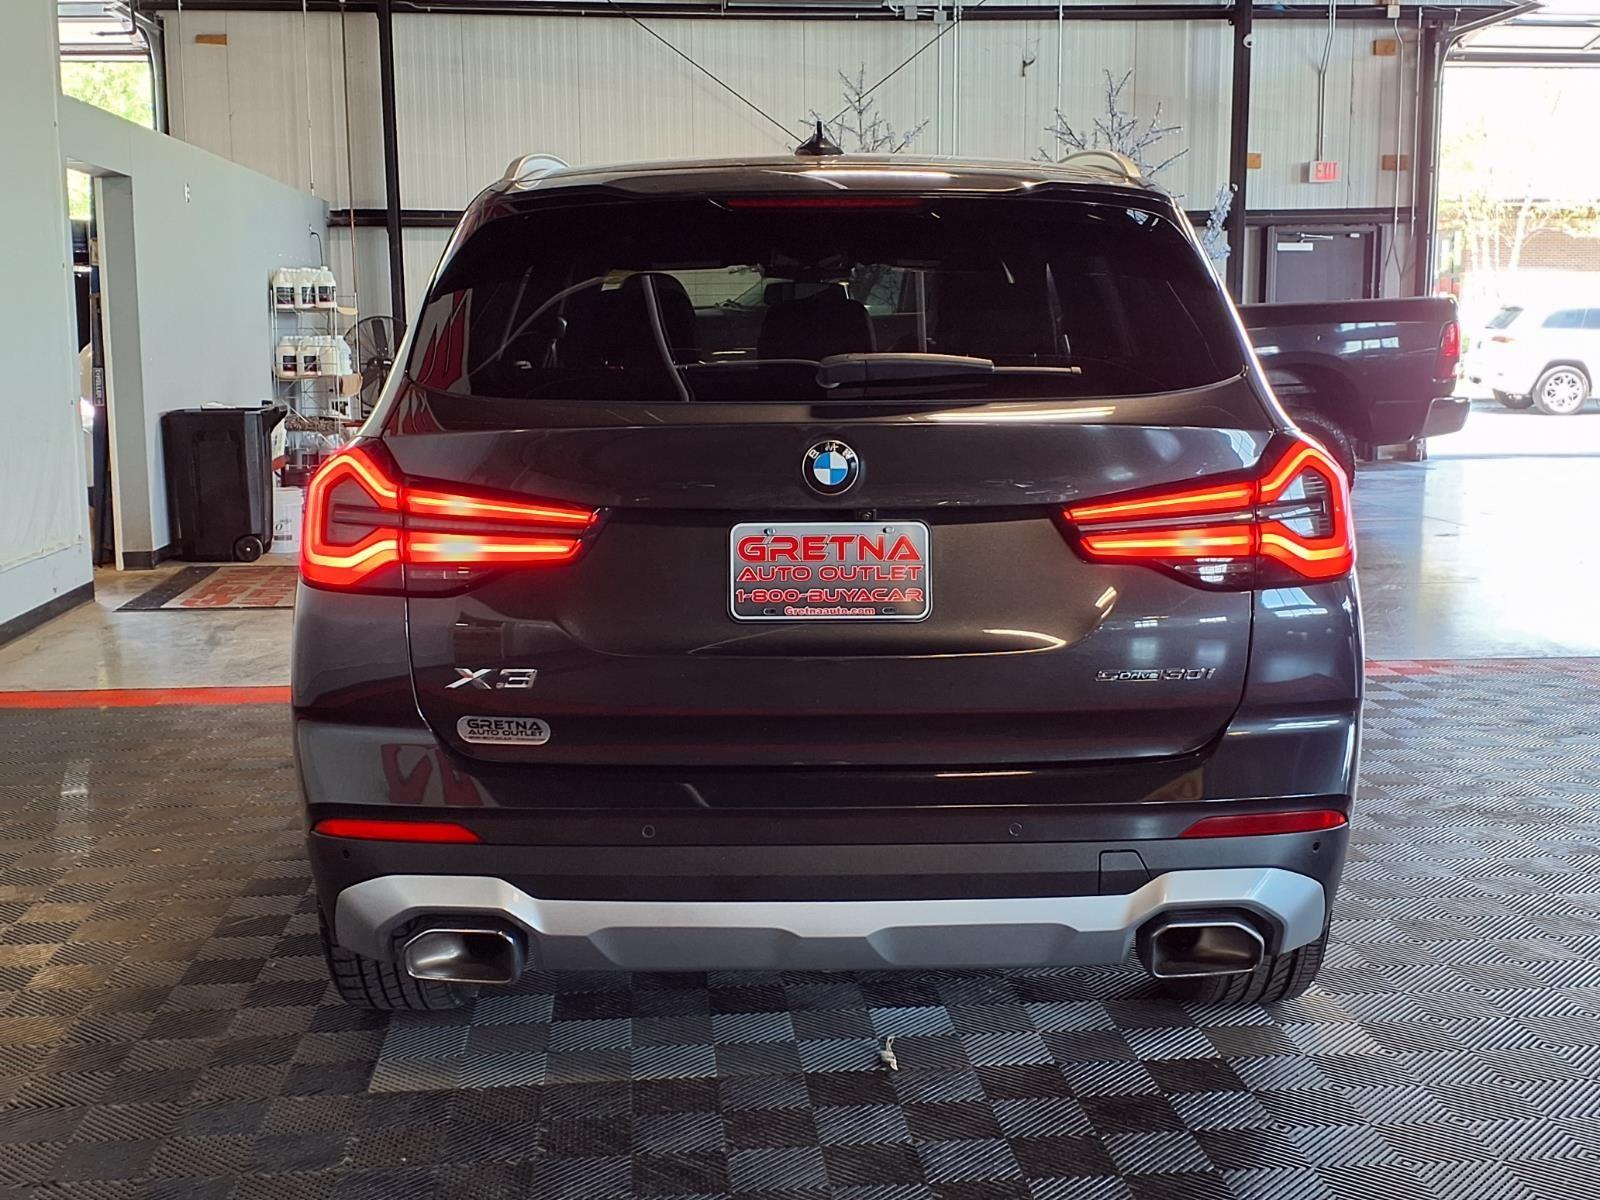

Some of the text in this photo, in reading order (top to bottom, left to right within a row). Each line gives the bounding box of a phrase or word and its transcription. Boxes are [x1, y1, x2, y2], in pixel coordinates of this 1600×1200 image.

[737, 535, 921, 562] GRETNA
[736, 565, 923, 582] AUTO OUTLET
[736, 588, 923, 603] 1-800-BUYACAR
[784, 606, 875, 615] Gretnaauto.com
[444, 667, 538, 690] X3
[467, 719, 543, 730] GRETNA
[468, 729, 544, 738] AUTO OUTLET
